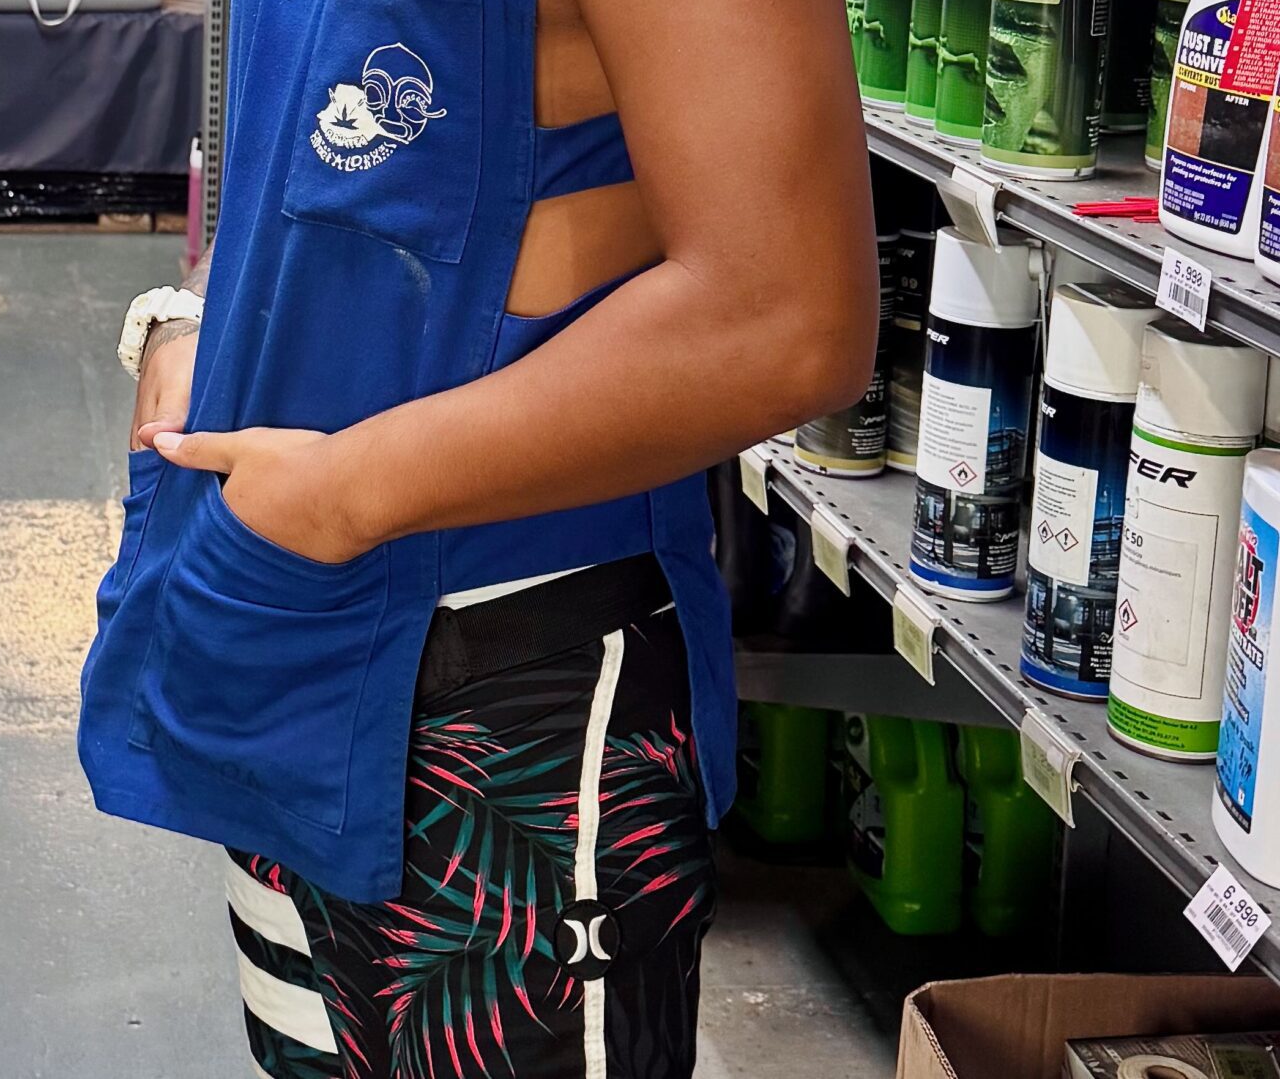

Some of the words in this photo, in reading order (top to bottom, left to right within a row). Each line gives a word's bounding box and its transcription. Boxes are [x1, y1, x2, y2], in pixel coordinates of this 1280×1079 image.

[1183, 29, 1211, 53] RUST
[1254, 48, 1268, 56] ACID
[1224, 94, 1250, 107] AFTER
[1222, 181, 1232, 190] oil
[1131, 531, 1144, 547] 50
[1223, 885, 1259, 928] 6.990
